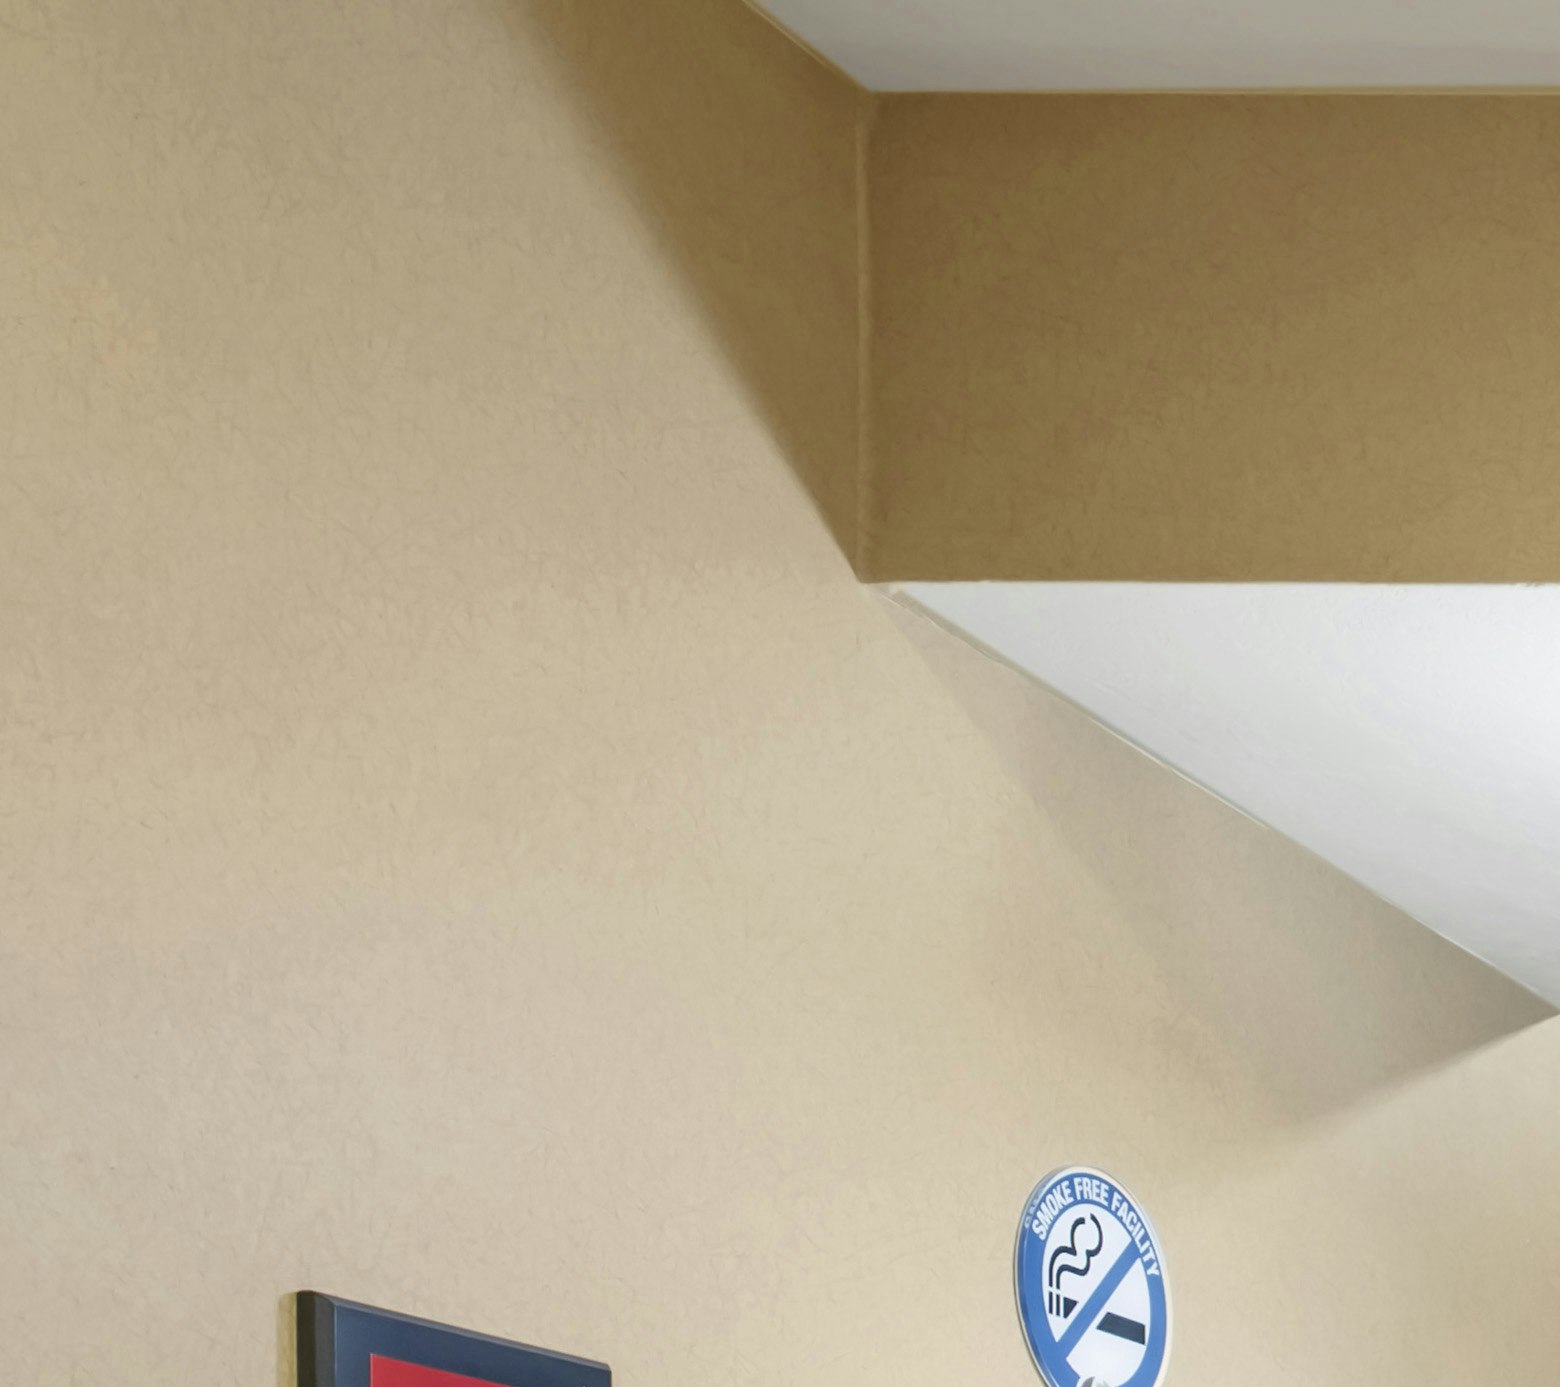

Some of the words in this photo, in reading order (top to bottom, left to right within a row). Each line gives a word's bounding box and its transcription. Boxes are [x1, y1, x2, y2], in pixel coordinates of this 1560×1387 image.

[1032, 1181, 1075, 1241] SMOKE
[1073, 1177, 1110, 1207] FREE
[1111, 1192, 1160, 1276] FACILITY
